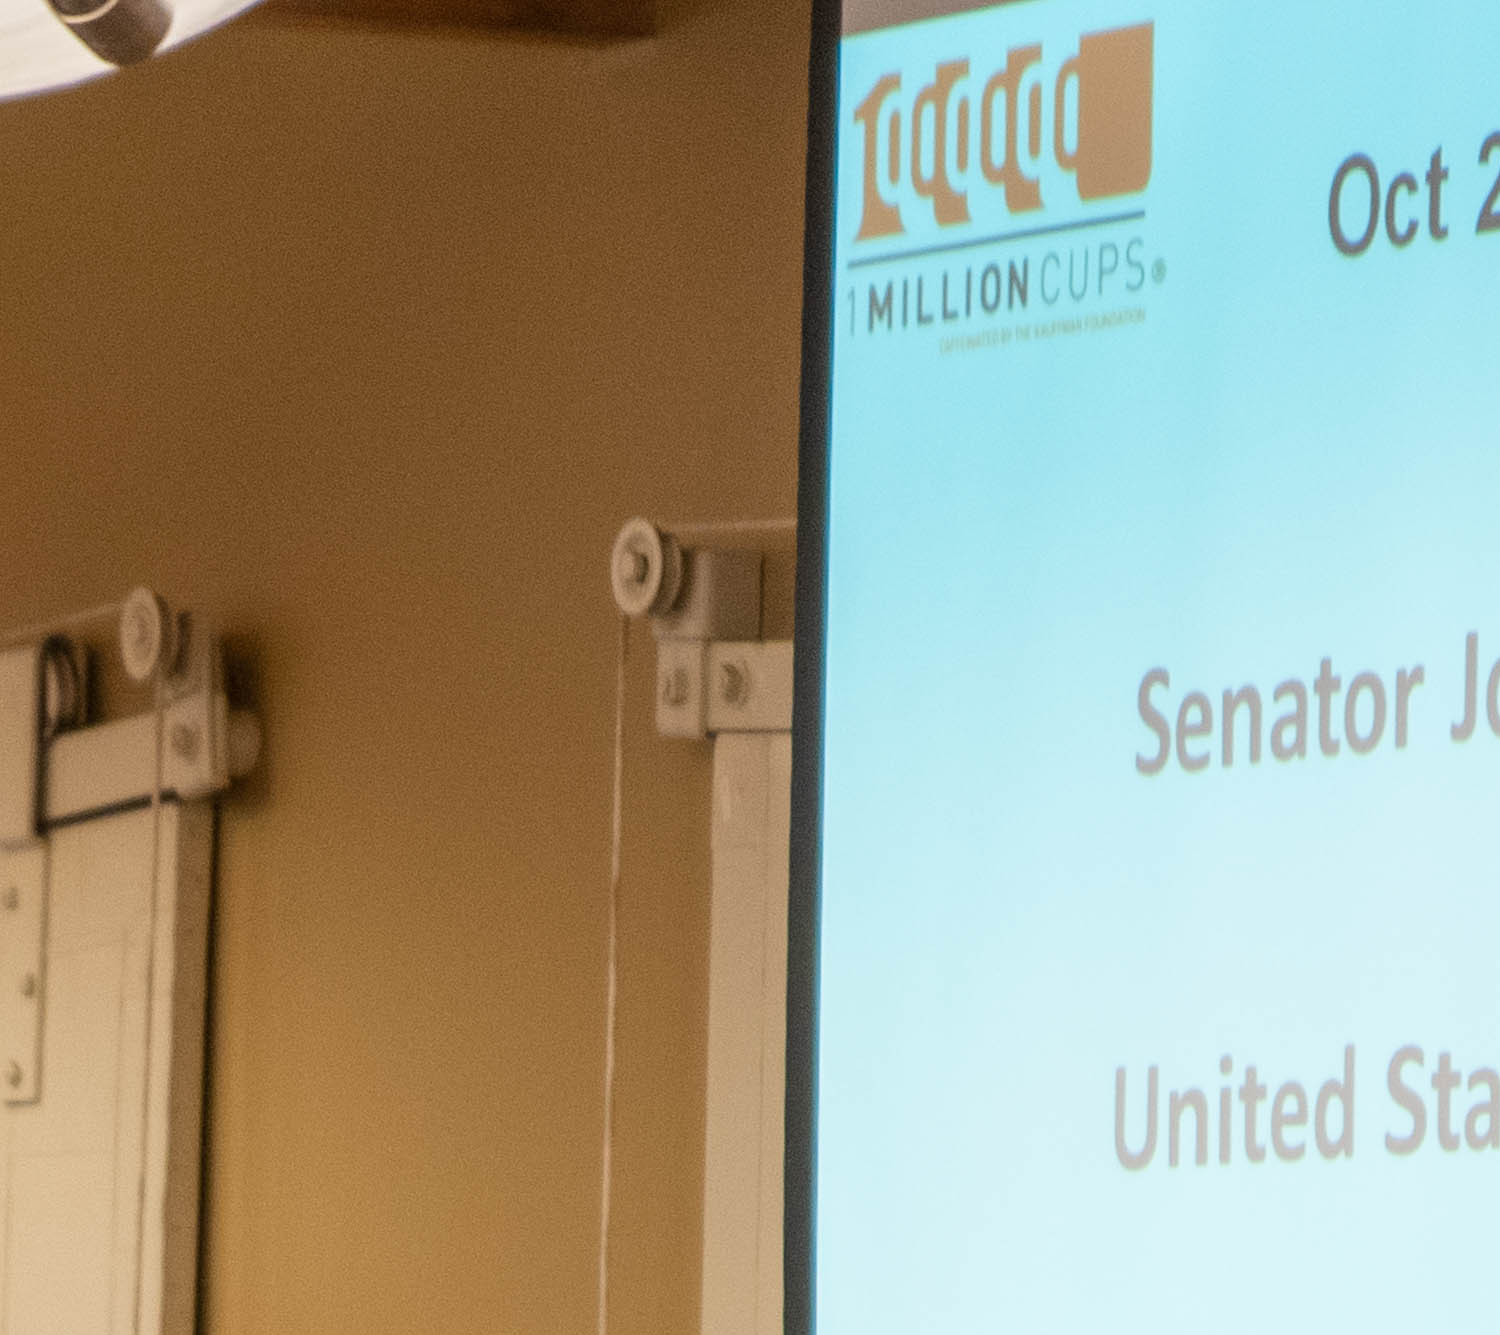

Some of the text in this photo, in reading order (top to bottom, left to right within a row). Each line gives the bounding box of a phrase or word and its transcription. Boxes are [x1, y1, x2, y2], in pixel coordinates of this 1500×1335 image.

[1327, 145, 1450, 258] Oct
[868, 255, 1029, 335] MILLION
[1132, 659, 1425, 778] Senator
[1111, 1044, 1358, 1174] United
